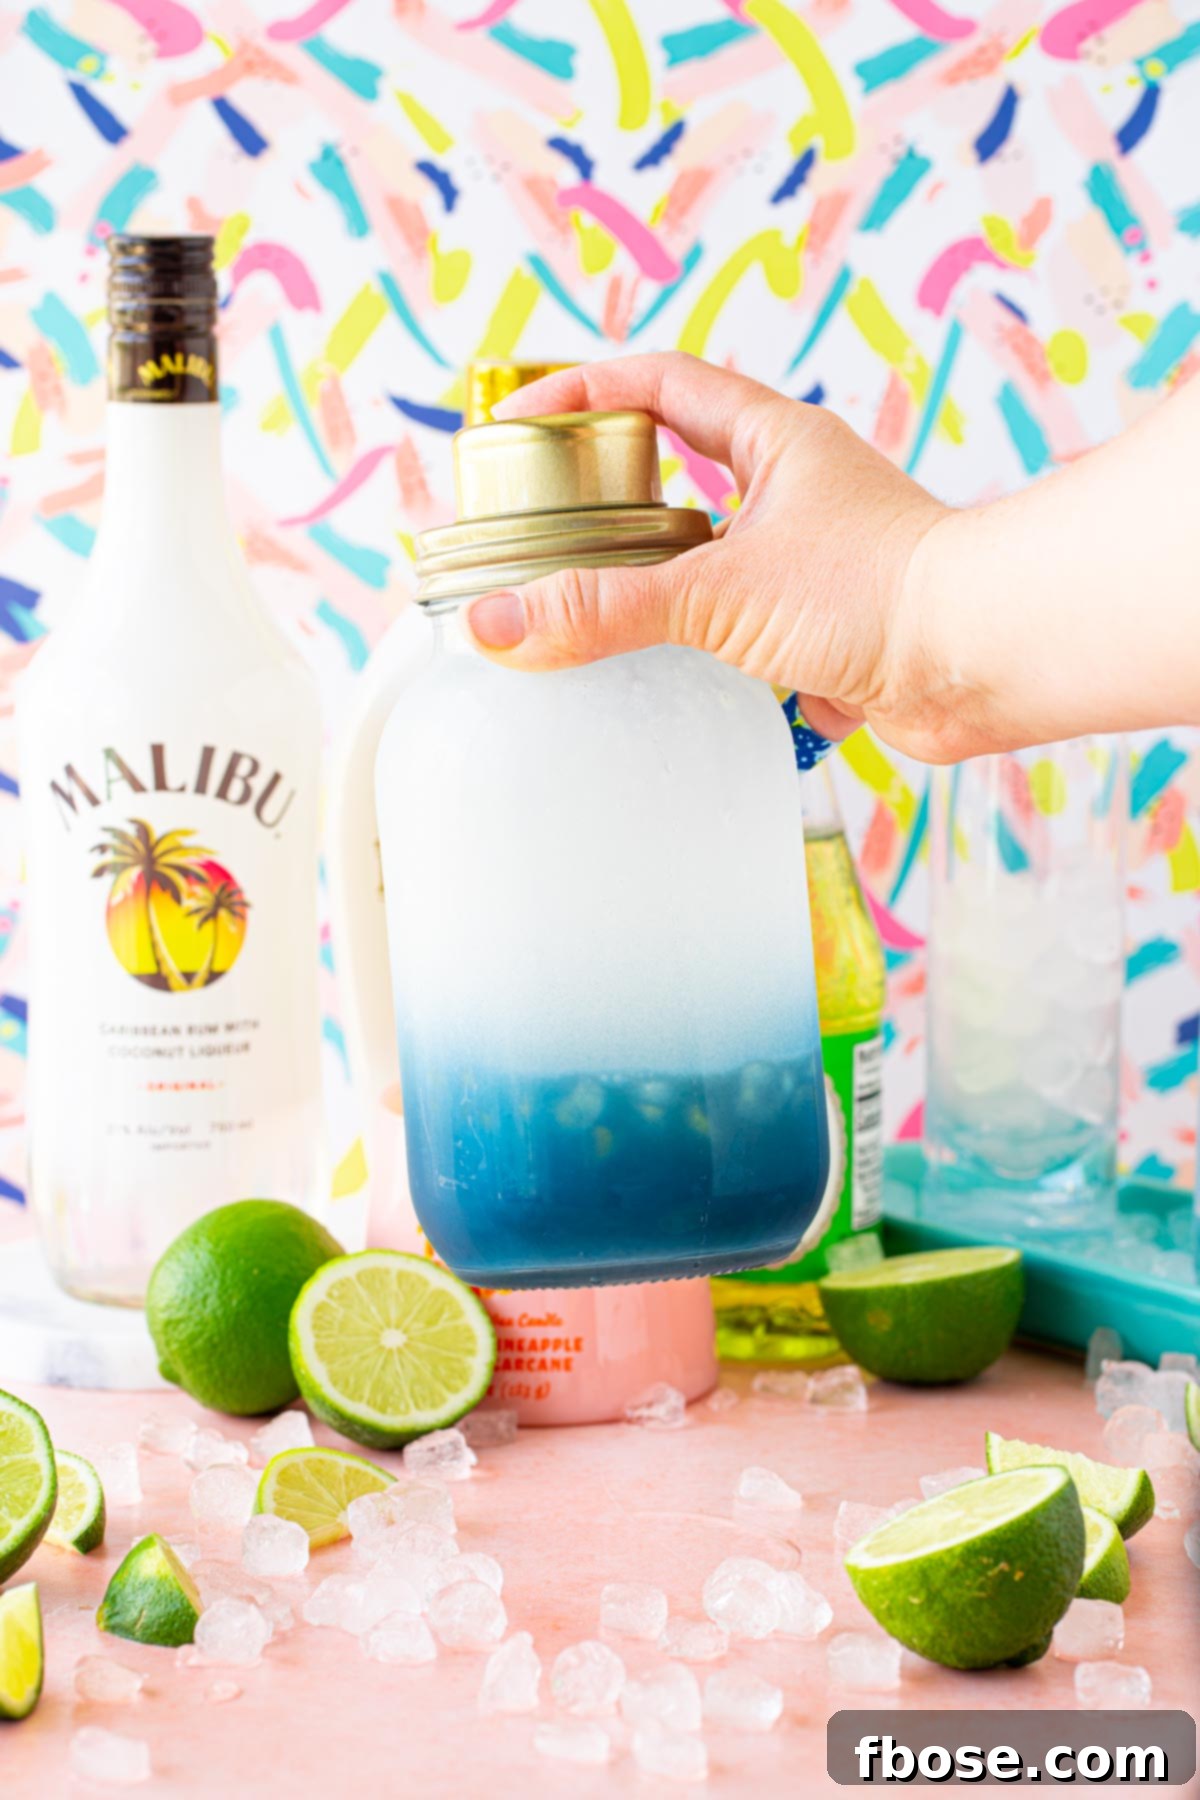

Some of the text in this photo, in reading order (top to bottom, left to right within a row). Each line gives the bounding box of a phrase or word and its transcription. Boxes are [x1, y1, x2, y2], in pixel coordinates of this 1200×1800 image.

[50, 743, 296, 833] MALIBU
[496, 1337, 584, 1352] INEAPPLE
[494, 1357, 574, 1372] ARCANE
